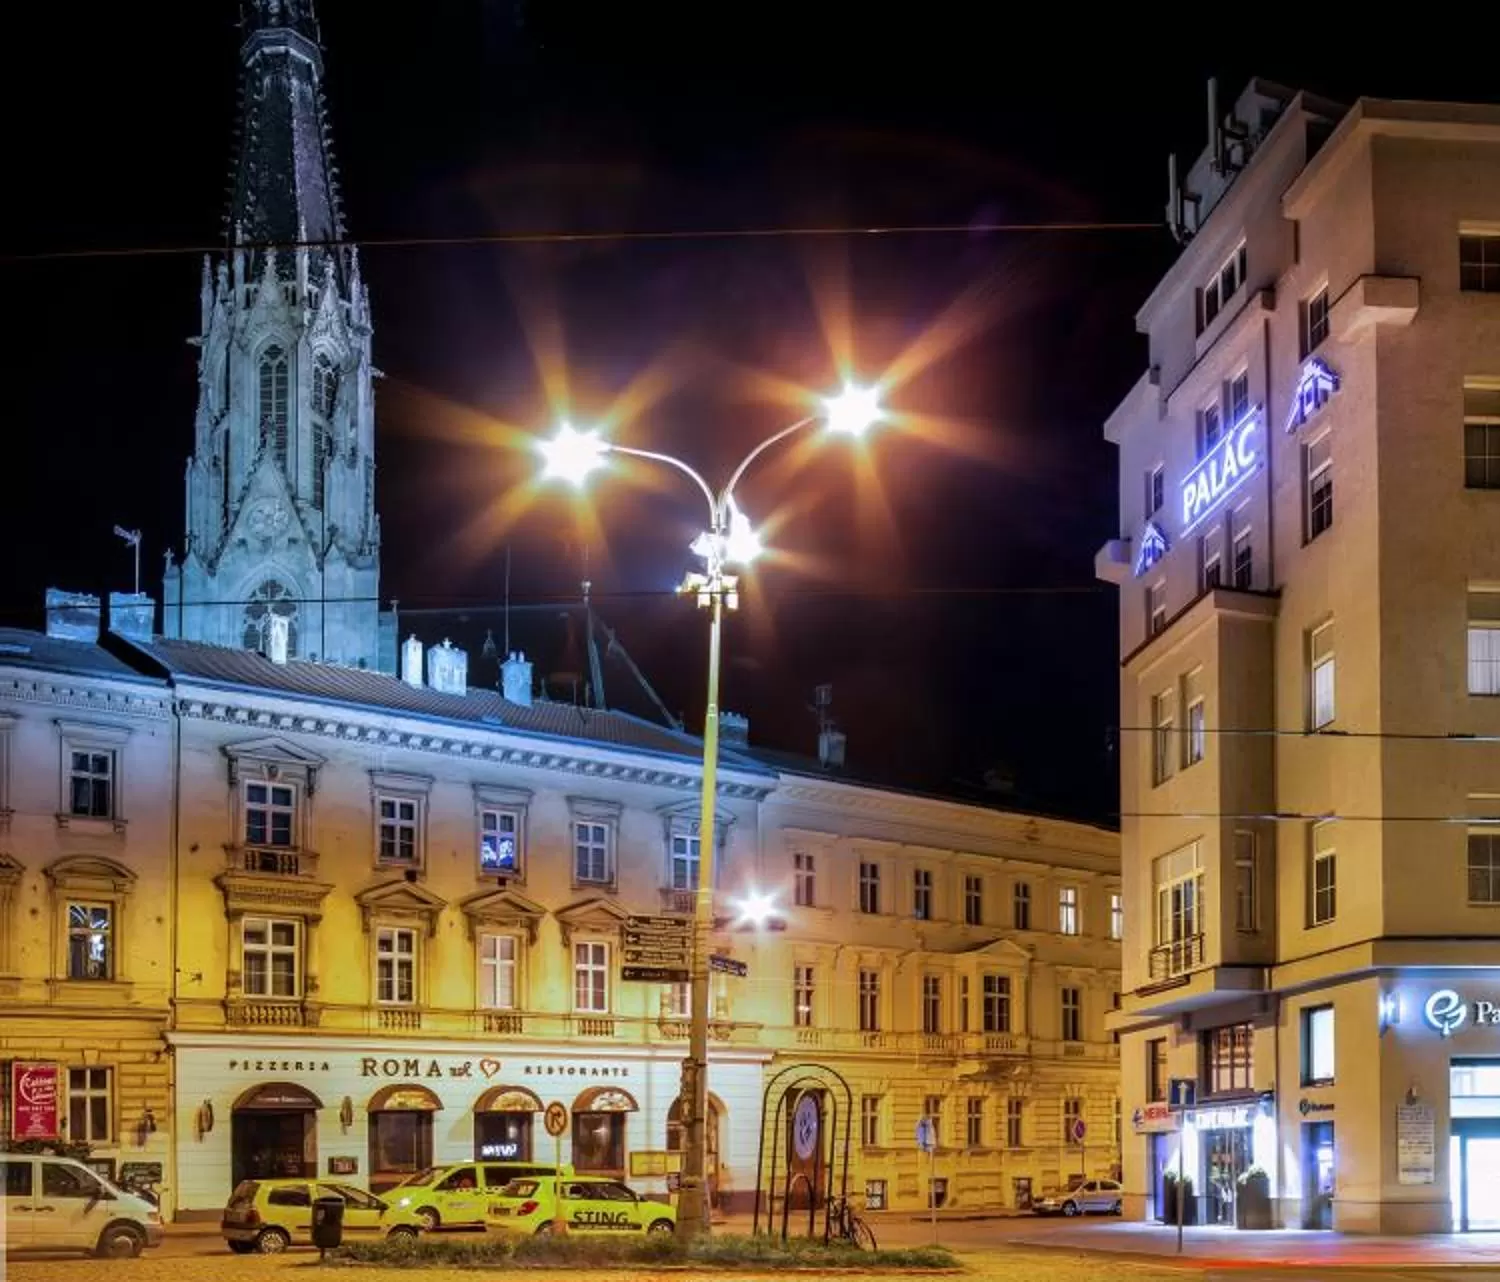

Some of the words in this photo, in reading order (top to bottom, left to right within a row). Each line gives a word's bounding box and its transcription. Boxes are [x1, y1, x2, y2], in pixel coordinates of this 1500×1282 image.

[1182, 420, 1257, 525] PALÁC
[229, 1061, 330, 1071] PIZZERIA
[361, 1058, 442, 1077] ROMA
[524, 1065, 630, 1077] RISTORANTE
[573, 1211, 629, 1225] STING
